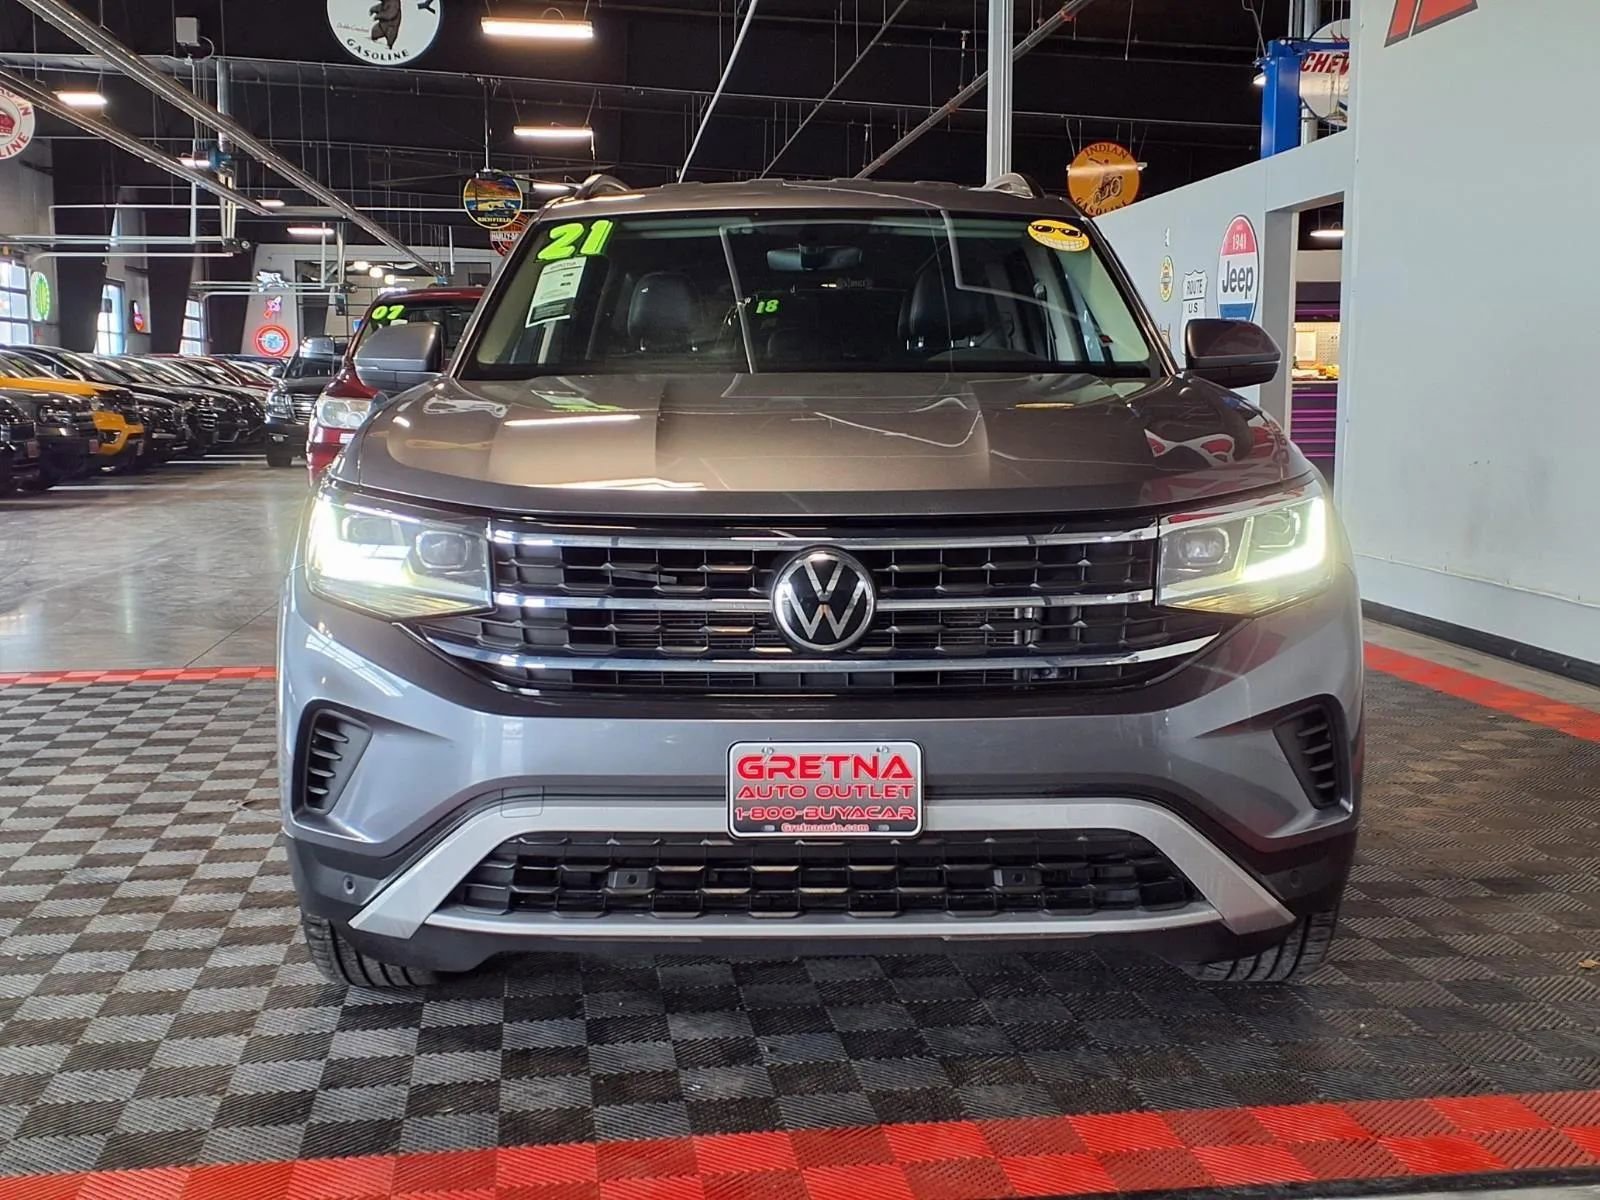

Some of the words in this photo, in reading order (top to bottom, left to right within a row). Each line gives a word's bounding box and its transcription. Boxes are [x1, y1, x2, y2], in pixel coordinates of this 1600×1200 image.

[346, 38, 410, 61] GASOLINE
[1084, 143, 1129, 160] INDIAN
[536, 219, 614, 261] 21
[1186, 278, 1203, 296] ROUTE
[1222, 260, 1254, 300] Jeep
[371, 304, 405, 320] 07
[756, 299, 779, 314] 18
[1188, 302, 1199, 314] US
[737, 754, 914, 781] GRETNA
[736, 785, 807, 800] AUTO
[815, 784, 916, 799] OUTLET
[735, 805, 916, 821] 1-800-BUYACAR
